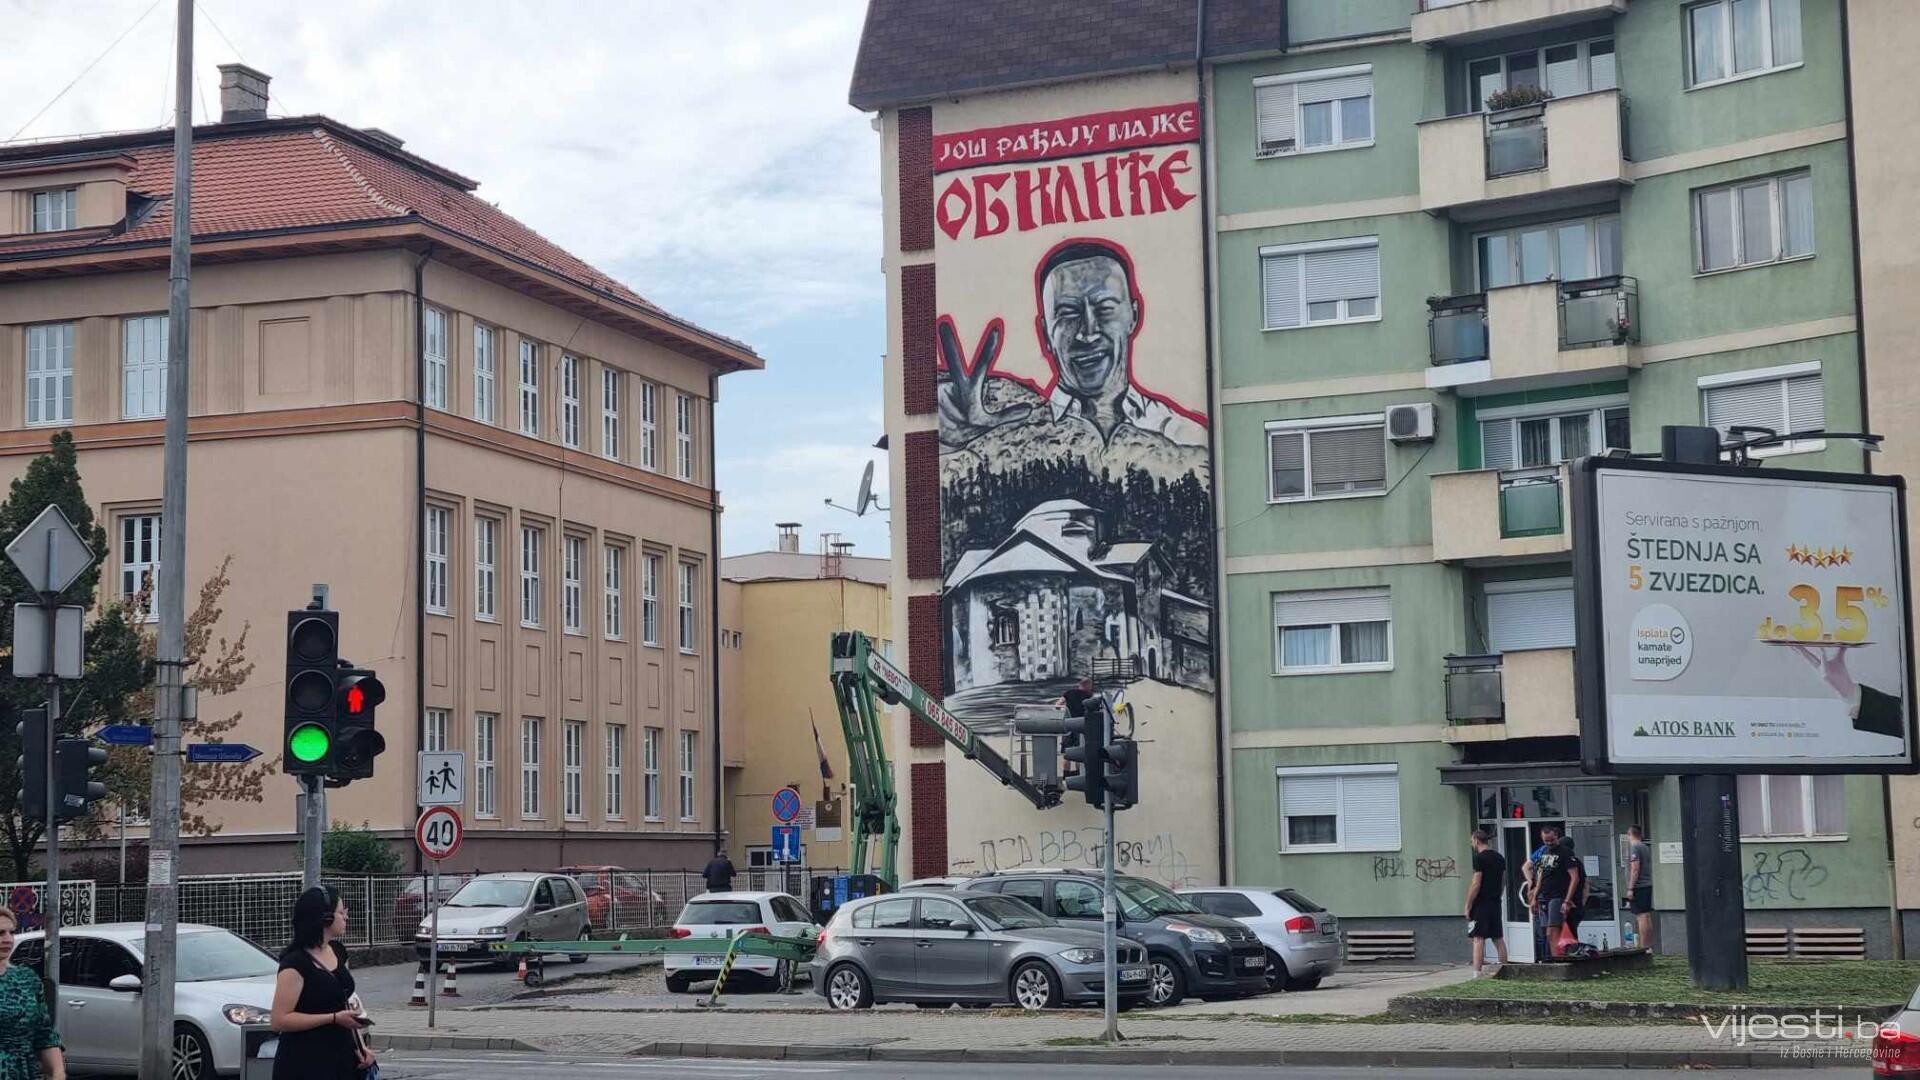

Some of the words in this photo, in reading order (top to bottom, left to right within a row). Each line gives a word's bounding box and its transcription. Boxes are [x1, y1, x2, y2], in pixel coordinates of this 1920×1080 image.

[940, 138, 986, 162] ЈОШ
[996, 125, 1099, 157] РАЂАЈУ
[1108, 110, 1196, 143] МАЈКЕ
[936, 150, 1197, 240] ОБИЛИЋЕ
[1625, 511, 1689, 528] Servirana
[1692, 517, 1700, 528] s
[1703, 517, 1764, 533] pažnjom.
[1627, 532, 1729, 562] ŠTEDNJA
[1733, 542, 1762, 564] SA
[1629, 565, 1643, 590] 5
[1649, 571, 1765, 595] ZVJEZDICA.
[1758, 616, 1788, 640] do
[1638, 641, 1672, 651] kamate
[1638, 655, 1682, 667] unaprijed
[1651, 721, 1689, 735] ATOS
[1694, 721, 1735, 736] BANK
[426, 820, 454, 847] 40
